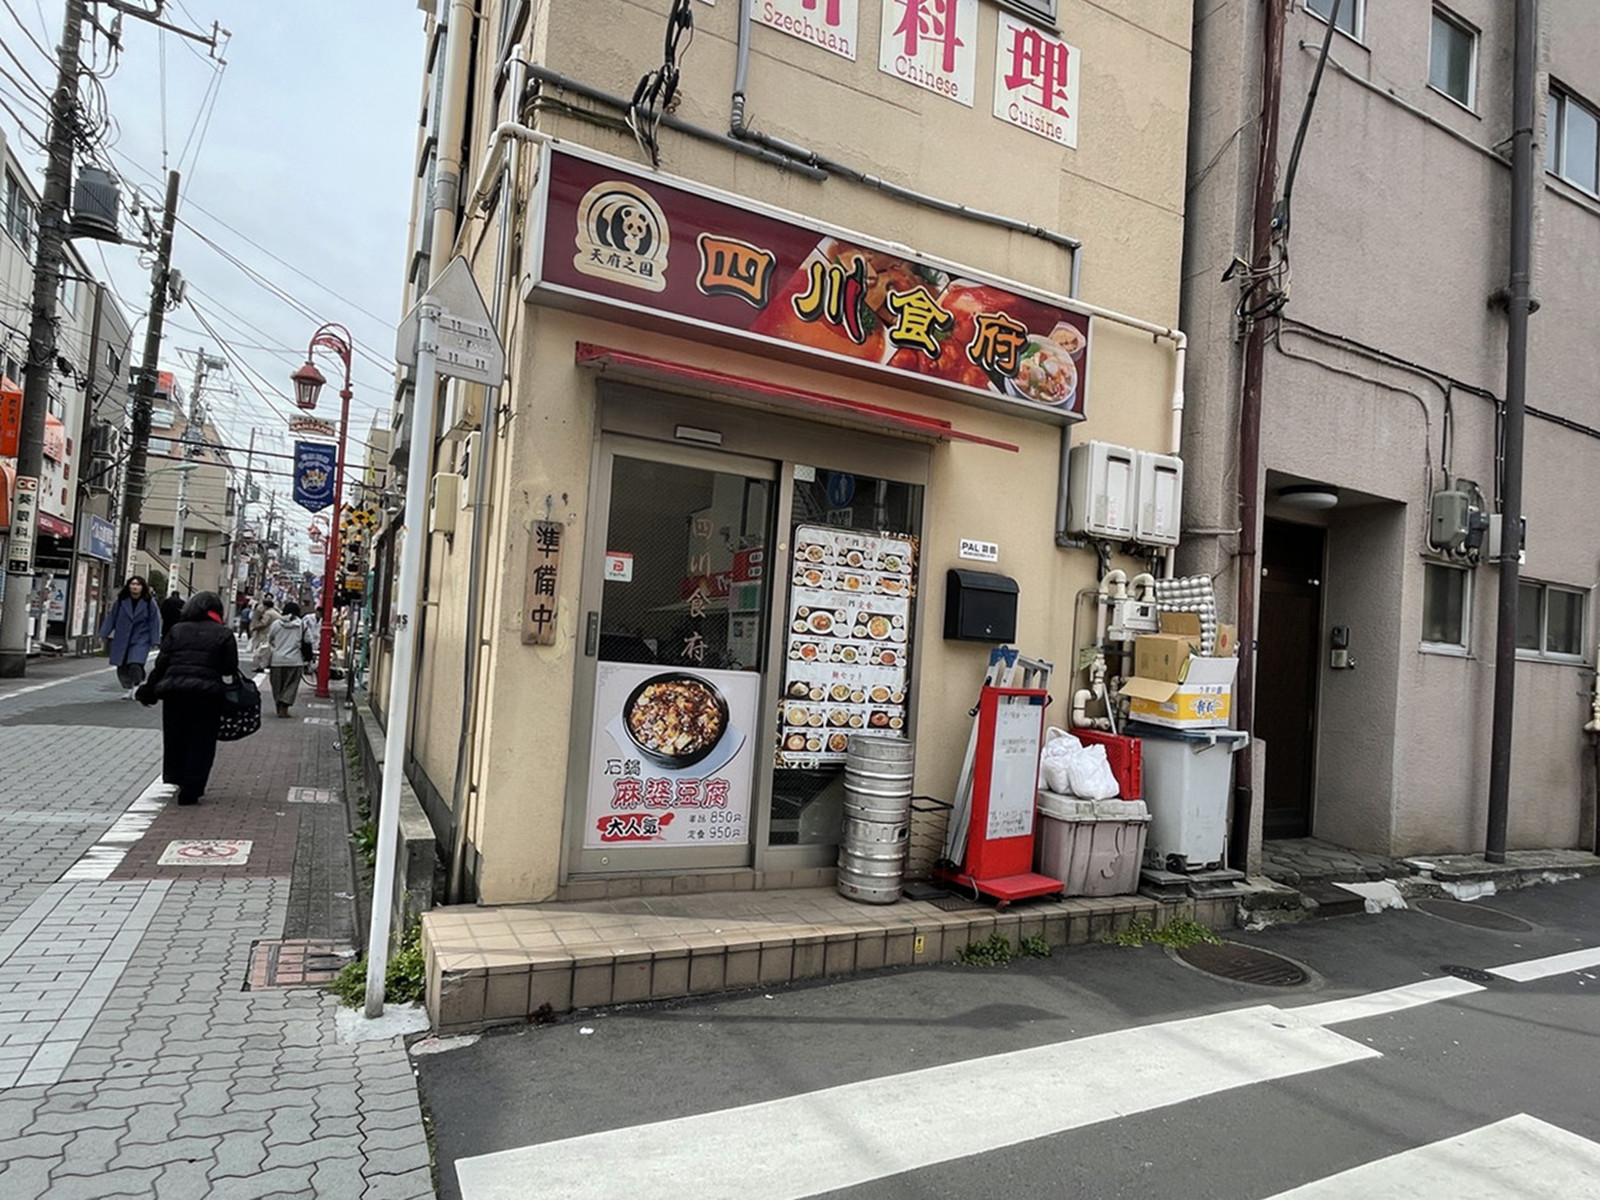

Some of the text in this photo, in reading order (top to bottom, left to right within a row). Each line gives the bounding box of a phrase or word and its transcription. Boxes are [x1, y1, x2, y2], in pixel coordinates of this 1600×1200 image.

[895, 55, 959, 97] Chinese
[1004, 24, 1070, 119] 理
[1008, 103, 1064, 141] Cuisine
[696, 231, 1029, 378] 四川食府
[531, 525, 560, 635] 準備中
[604, 758, 642, 776] 石鍋
[611, 776, 731, 810] 麻婆豆腐
[606, 817, 660, 838] 大人気
